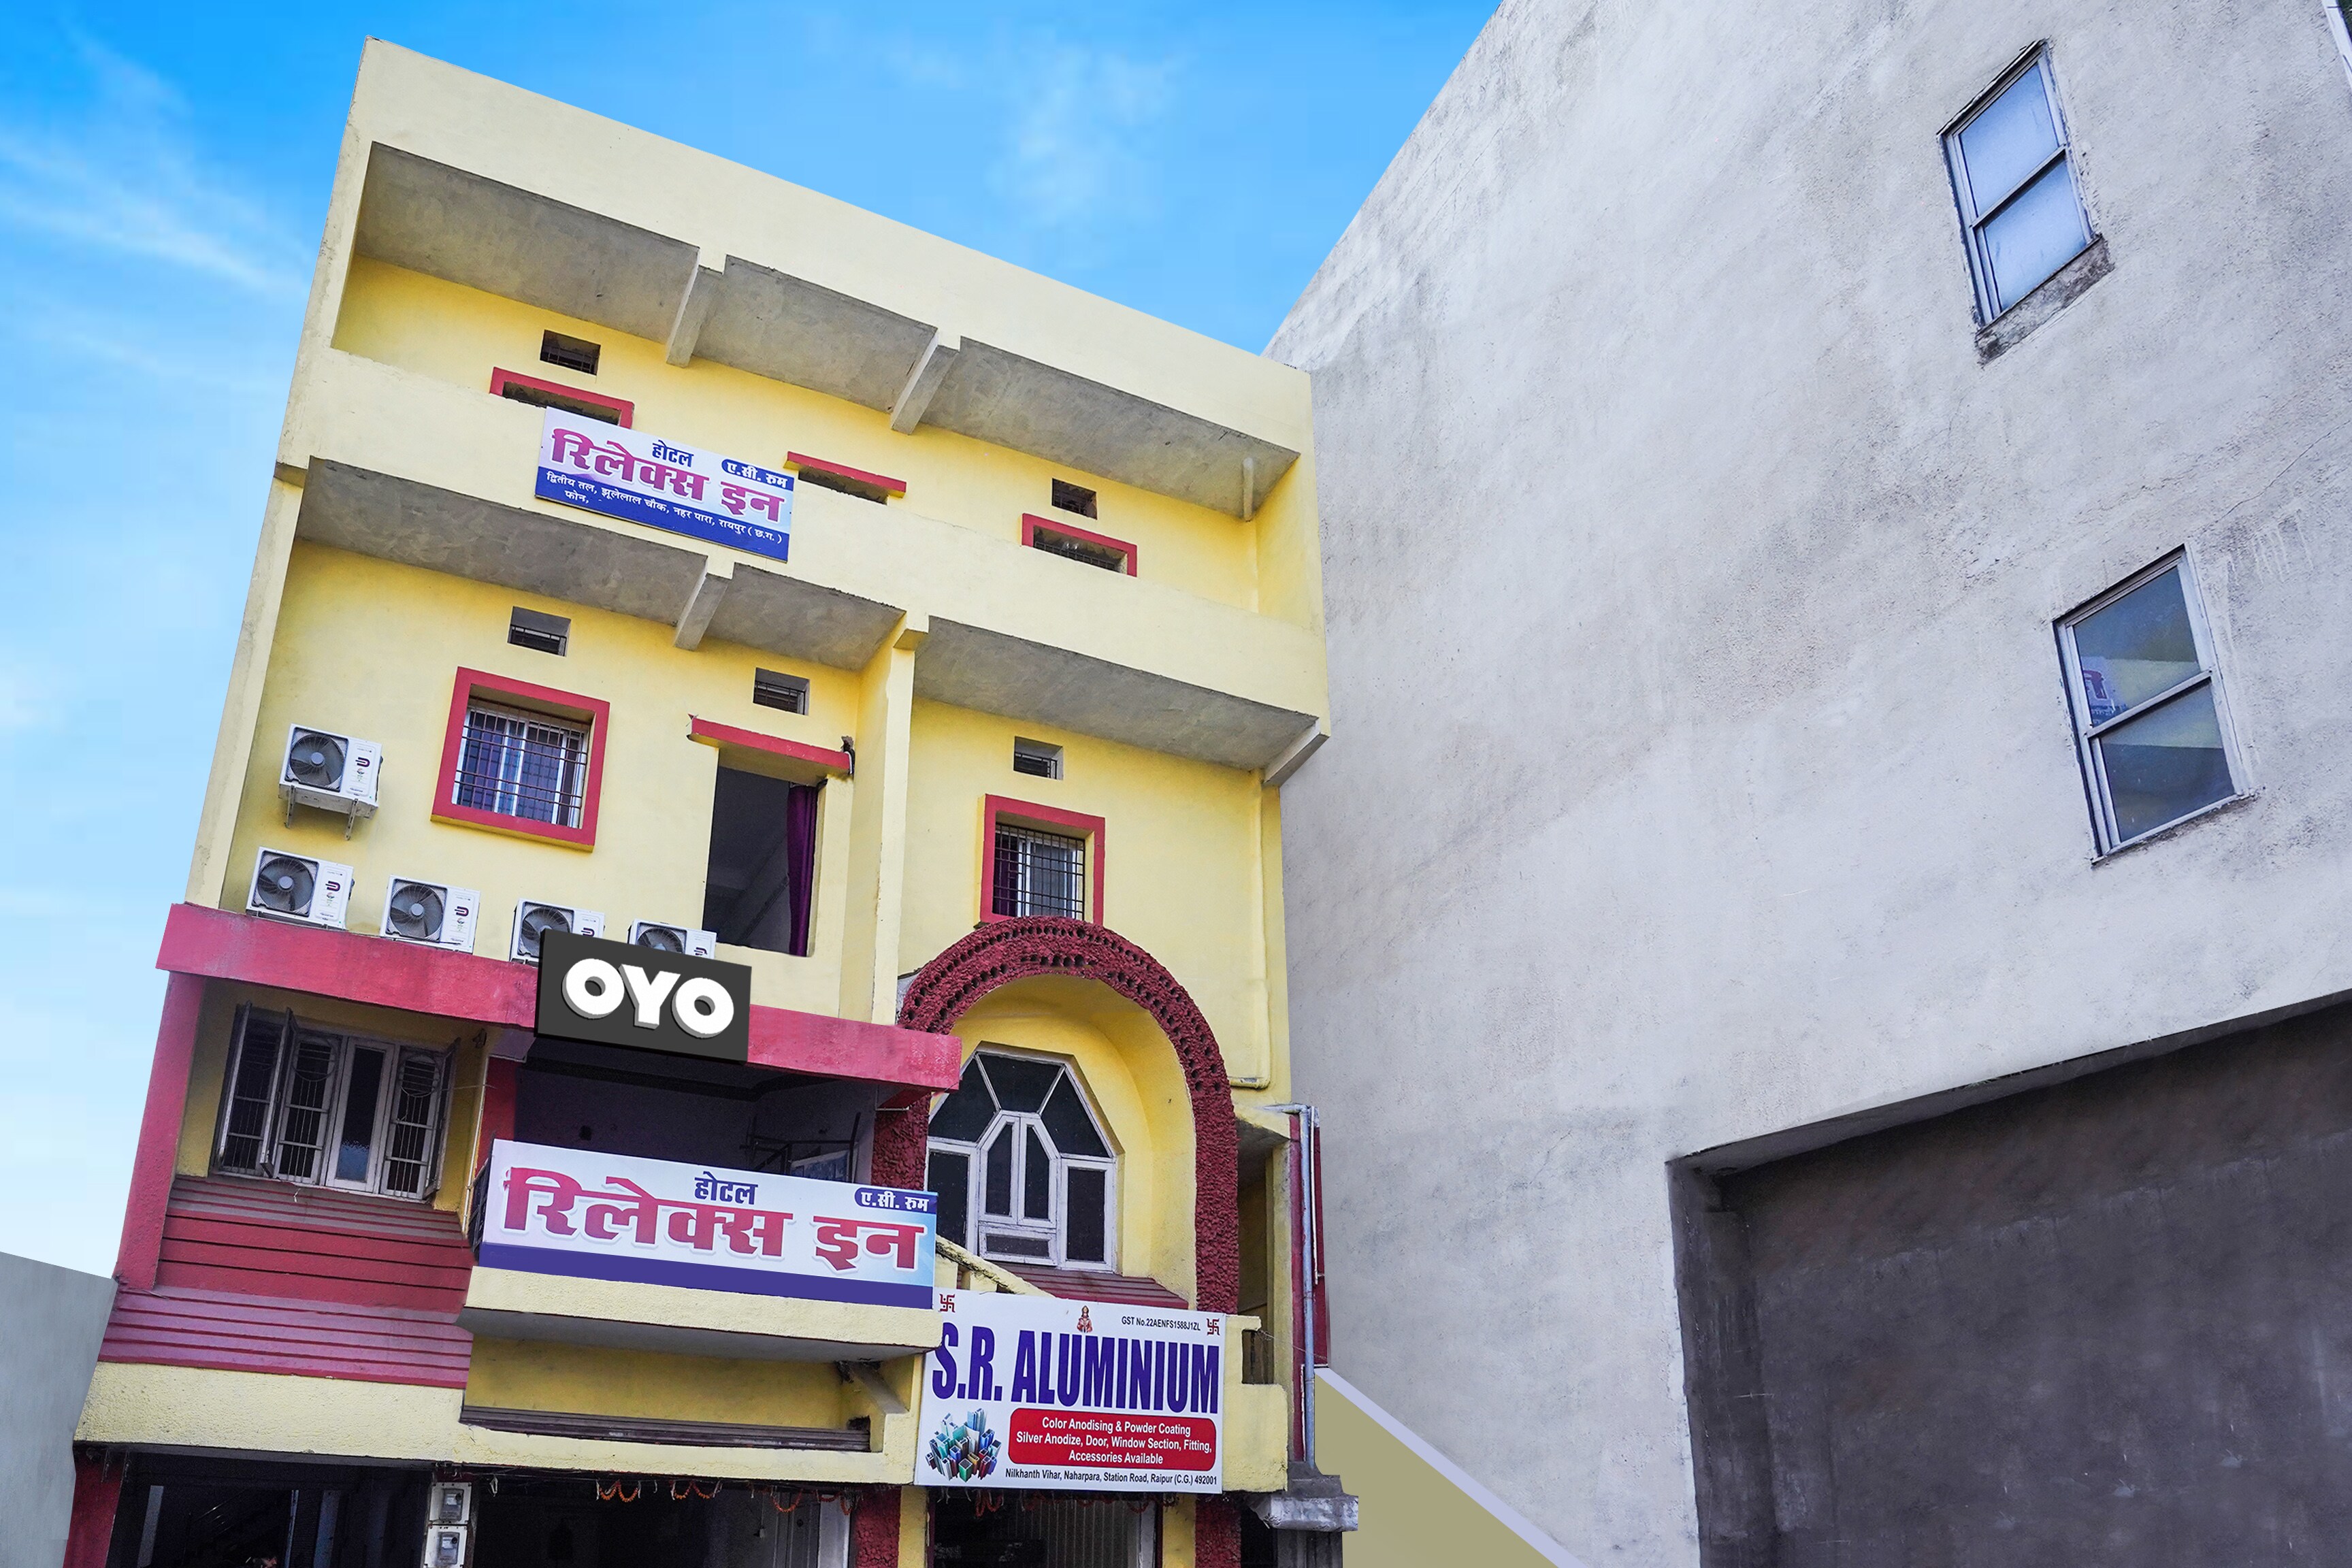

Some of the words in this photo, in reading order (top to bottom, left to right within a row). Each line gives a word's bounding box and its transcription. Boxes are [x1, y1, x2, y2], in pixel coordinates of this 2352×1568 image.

[652, 440, 694, 468] होटल
[551, 427, 710, 501] रिलेक्स
[720, 481, 785, 522] इन
[727, 461, 762, 481] ए.सी.
[546, 471, 576, 487] द्वितीय
[578, 480, 598, 494] तल,
[601, 487, 642, 505] झूलेलाल
[644, 497, 670, 514] चौक,
[673, 506, 693, 519] नहर
[693, 512, 715, 526] पारा,
[718, 518, 747, 534] रायपुर
[561, 957, 734, 1039] OYO
[693, 1171, 758, 1205] होटल
[860, 1190, 900, 1209] ए.सी.
[504, 1166, 794, 1257] रिलेक्स
[813, 1215, 924, 1271] इन
[1121, 1316, 1135, 1326] GST
[932, 1322, 1003, 1402] S.R.
[1011, 1329, 1219, 1414] ALUMINIUM
[1042, 1416, 1067, 1429] Color
[1068, 1418, 1113, 1435] Anodising
[1115, 1420, 1122, 1432] &
[1124, 1421, 1157, 1434] Powder
[1158, 1422, 1191, 1437] Coating
[1016, 1431, 1043, 1443] Silver
[1044, 1433, 1083, 1448] Anodize,
[1085, 1435, 1109, 1448] Door,
[1111, 1436, 1145, 1448] Window
[1147, 1437, 1181, 1452] Section,
[1183, 1439, 1212, 1454] Fitting,
[1068, 1450, 1122, 1463] Accessories
[1124, 1452, 1164, 1465] Available
[1005, 1468, 1040, 1479] Nilkhanth
[1042, 1469, 1062, 1481] Vihar,
[1064, 1470, 1102, 1483] Naharpara,
[1103, 1471, 1128, 1482] Station
[1129, 1473, 1149, 1484] Road,
[1150, 1473, 1173, 1485] Raipur
[1174, 1474, 1193, 1486] (C.G.)
[1194, 1475, 1218, 1485] 492001
